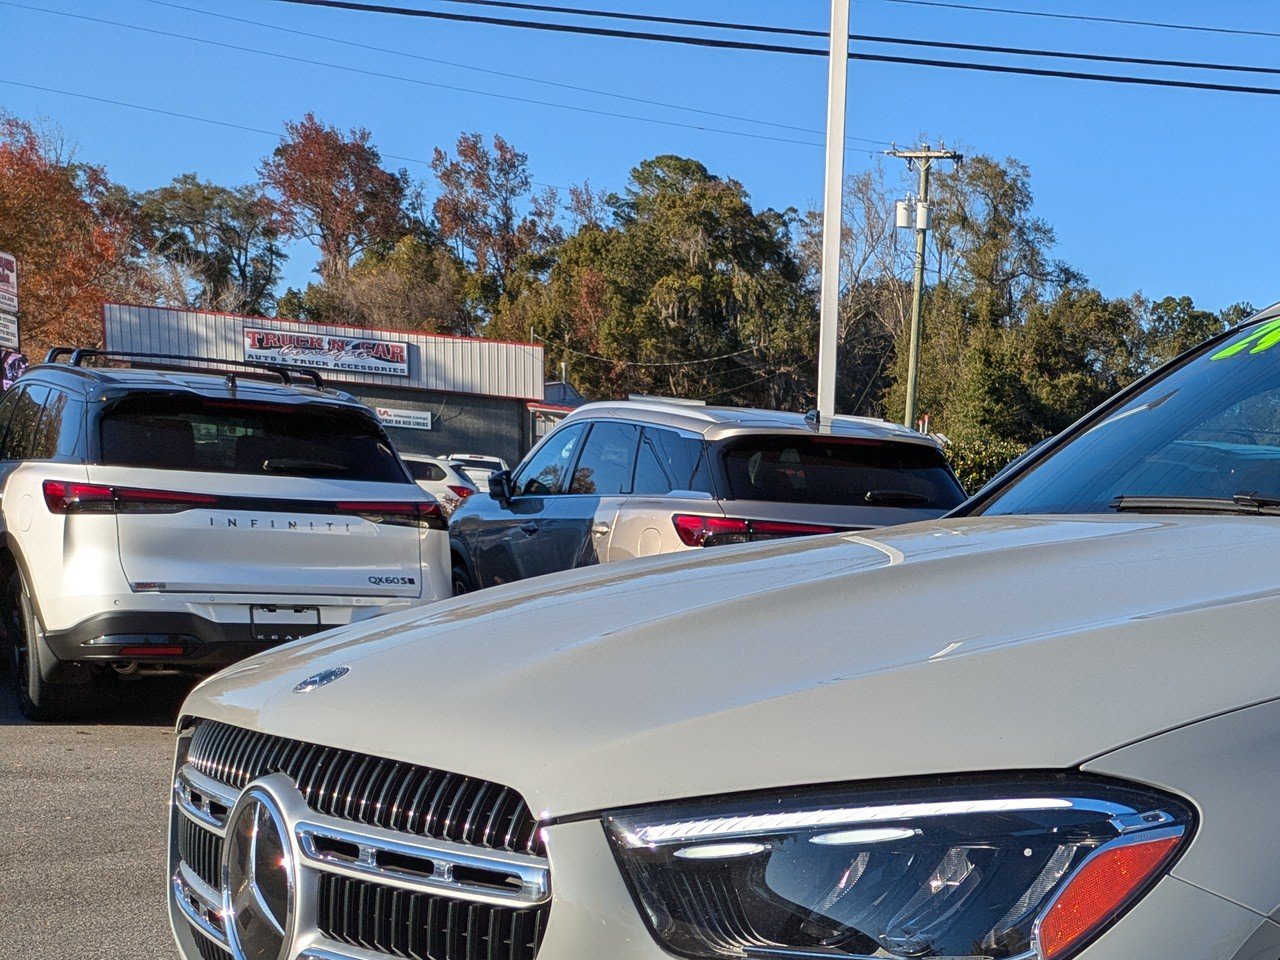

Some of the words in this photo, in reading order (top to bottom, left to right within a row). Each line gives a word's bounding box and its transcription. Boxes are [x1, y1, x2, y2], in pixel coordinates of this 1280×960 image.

[247, 331, 324, 350] TRUCK
[359, 341, 406, 364] CAR
[247, 354, 277, 362] AUTO
[292, 359, 329, 367] TRUCK
[333, 363, 406, 374] ACCESSORIES
[413, 420, 429, 428] LINERS
[209, 517, 350, 533] INFINITI
